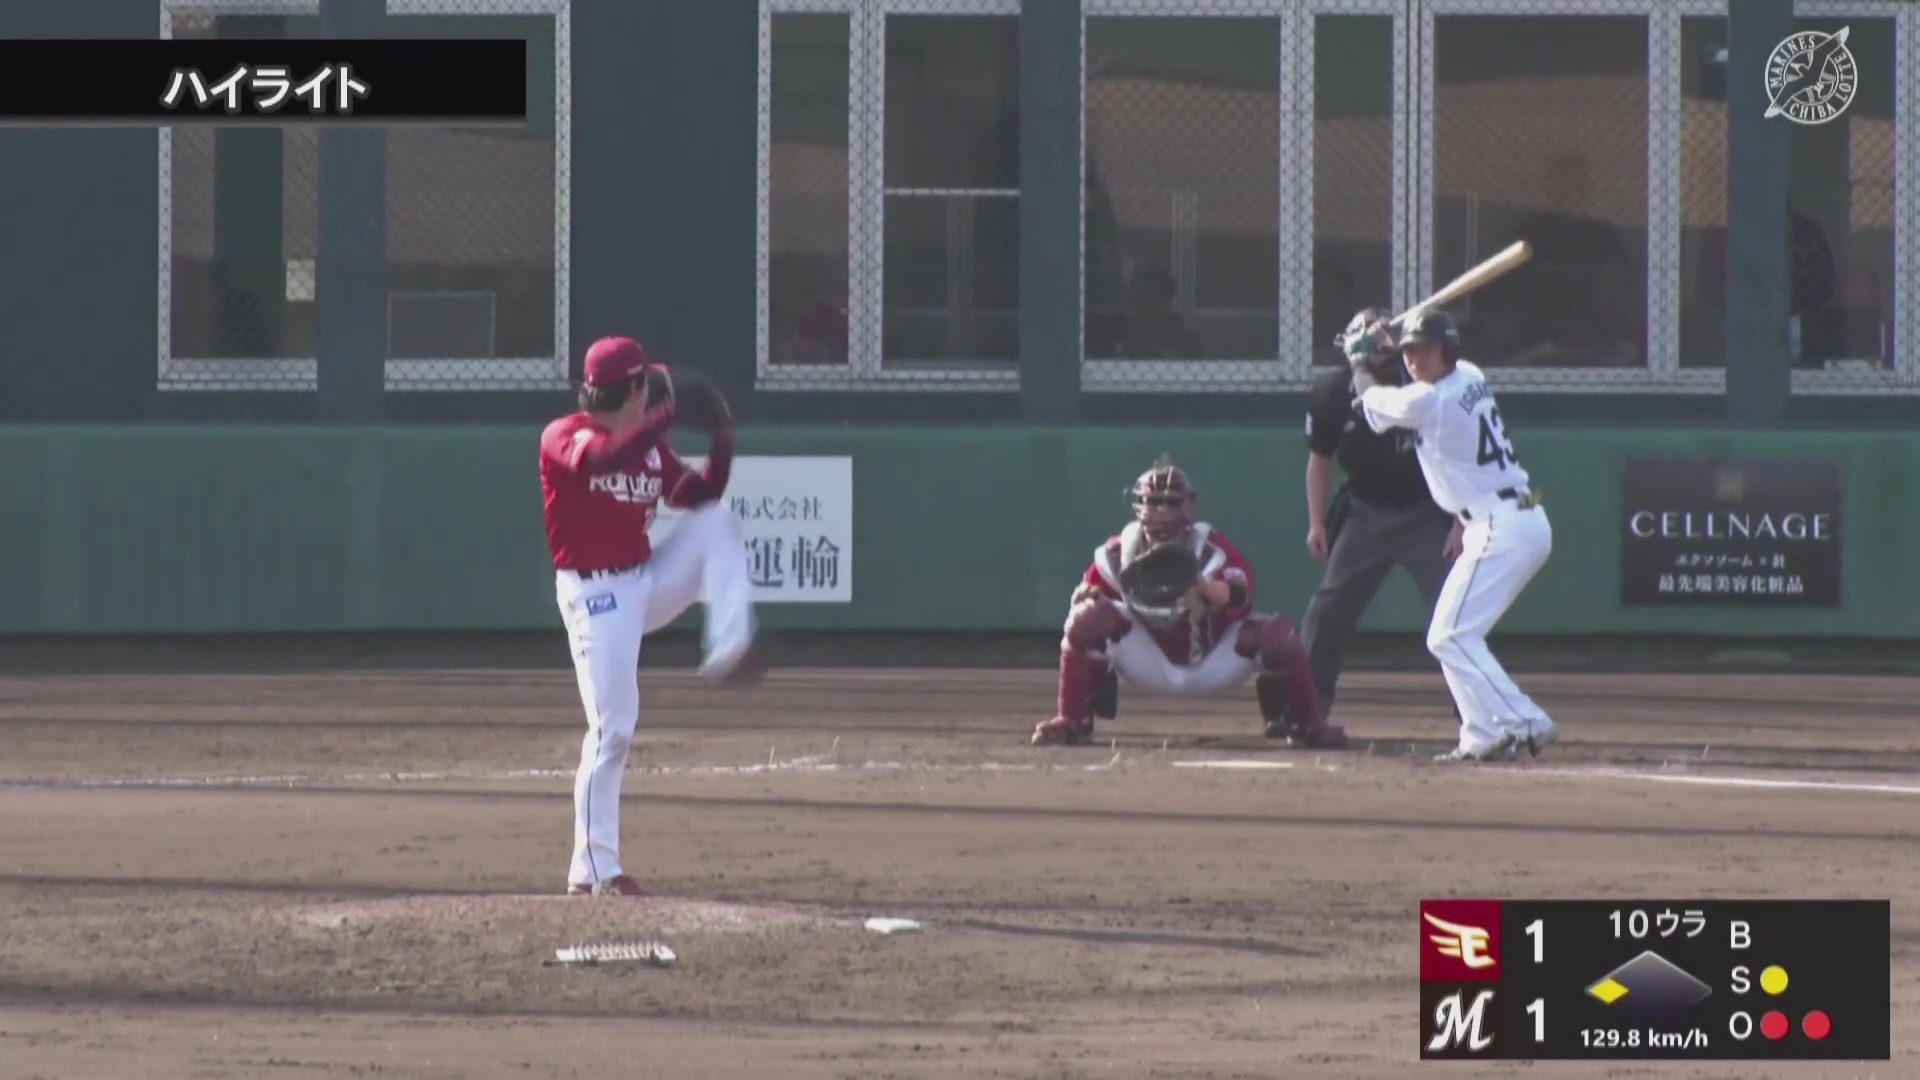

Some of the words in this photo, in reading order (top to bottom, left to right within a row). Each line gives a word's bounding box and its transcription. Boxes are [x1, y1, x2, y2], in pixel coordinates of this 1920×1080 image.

[1630, 511, 1831, 540] CELLNAGE
[744, 535, 841, 589] 運輸
[1658, 573, 1804, 593] 最先端美容化粧品
